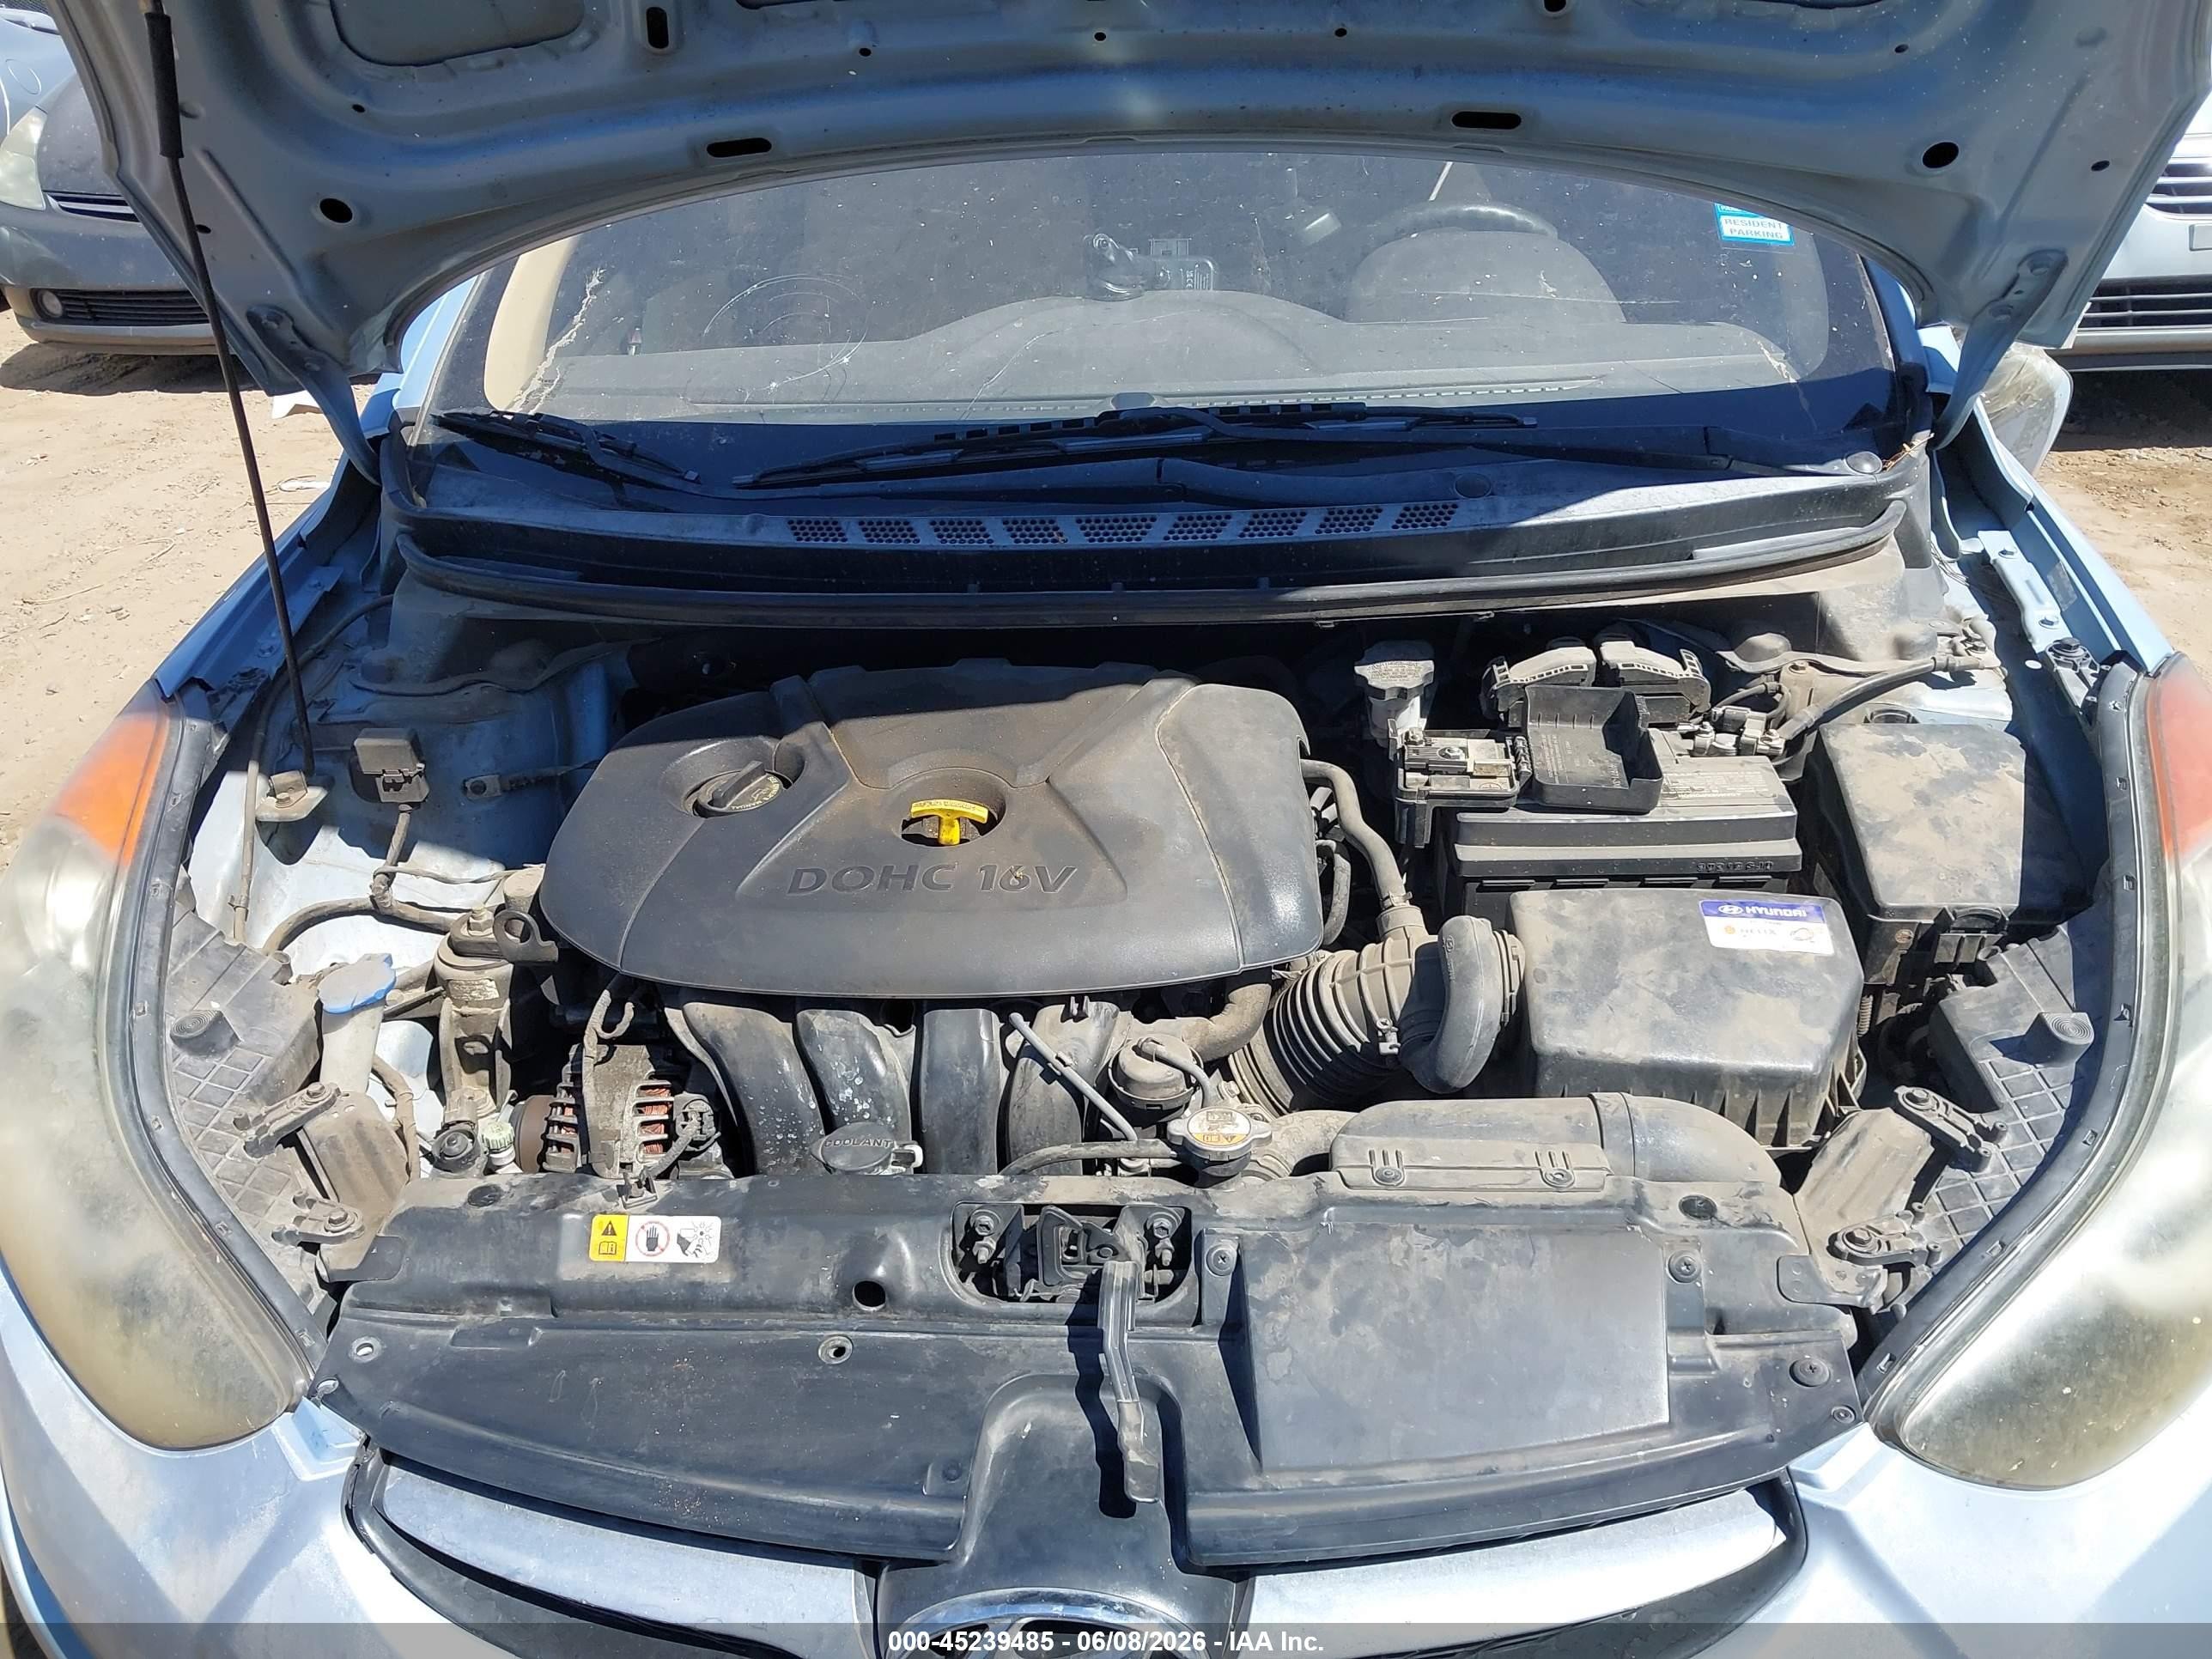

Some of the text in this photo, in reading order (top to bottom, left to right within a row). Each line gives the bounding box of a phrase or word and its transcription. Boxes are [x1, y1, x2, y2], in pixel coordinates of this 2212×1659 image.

[1723, 218, 1783, 229] RESIDENT
[1729, 228, 1784, 239] PARKING
[786, 862, 1078, 896] DOHC 16V
[1745, 906, 1808, 917] HYUNDAI
[824, 1139, 892, 1148] COOLANT
